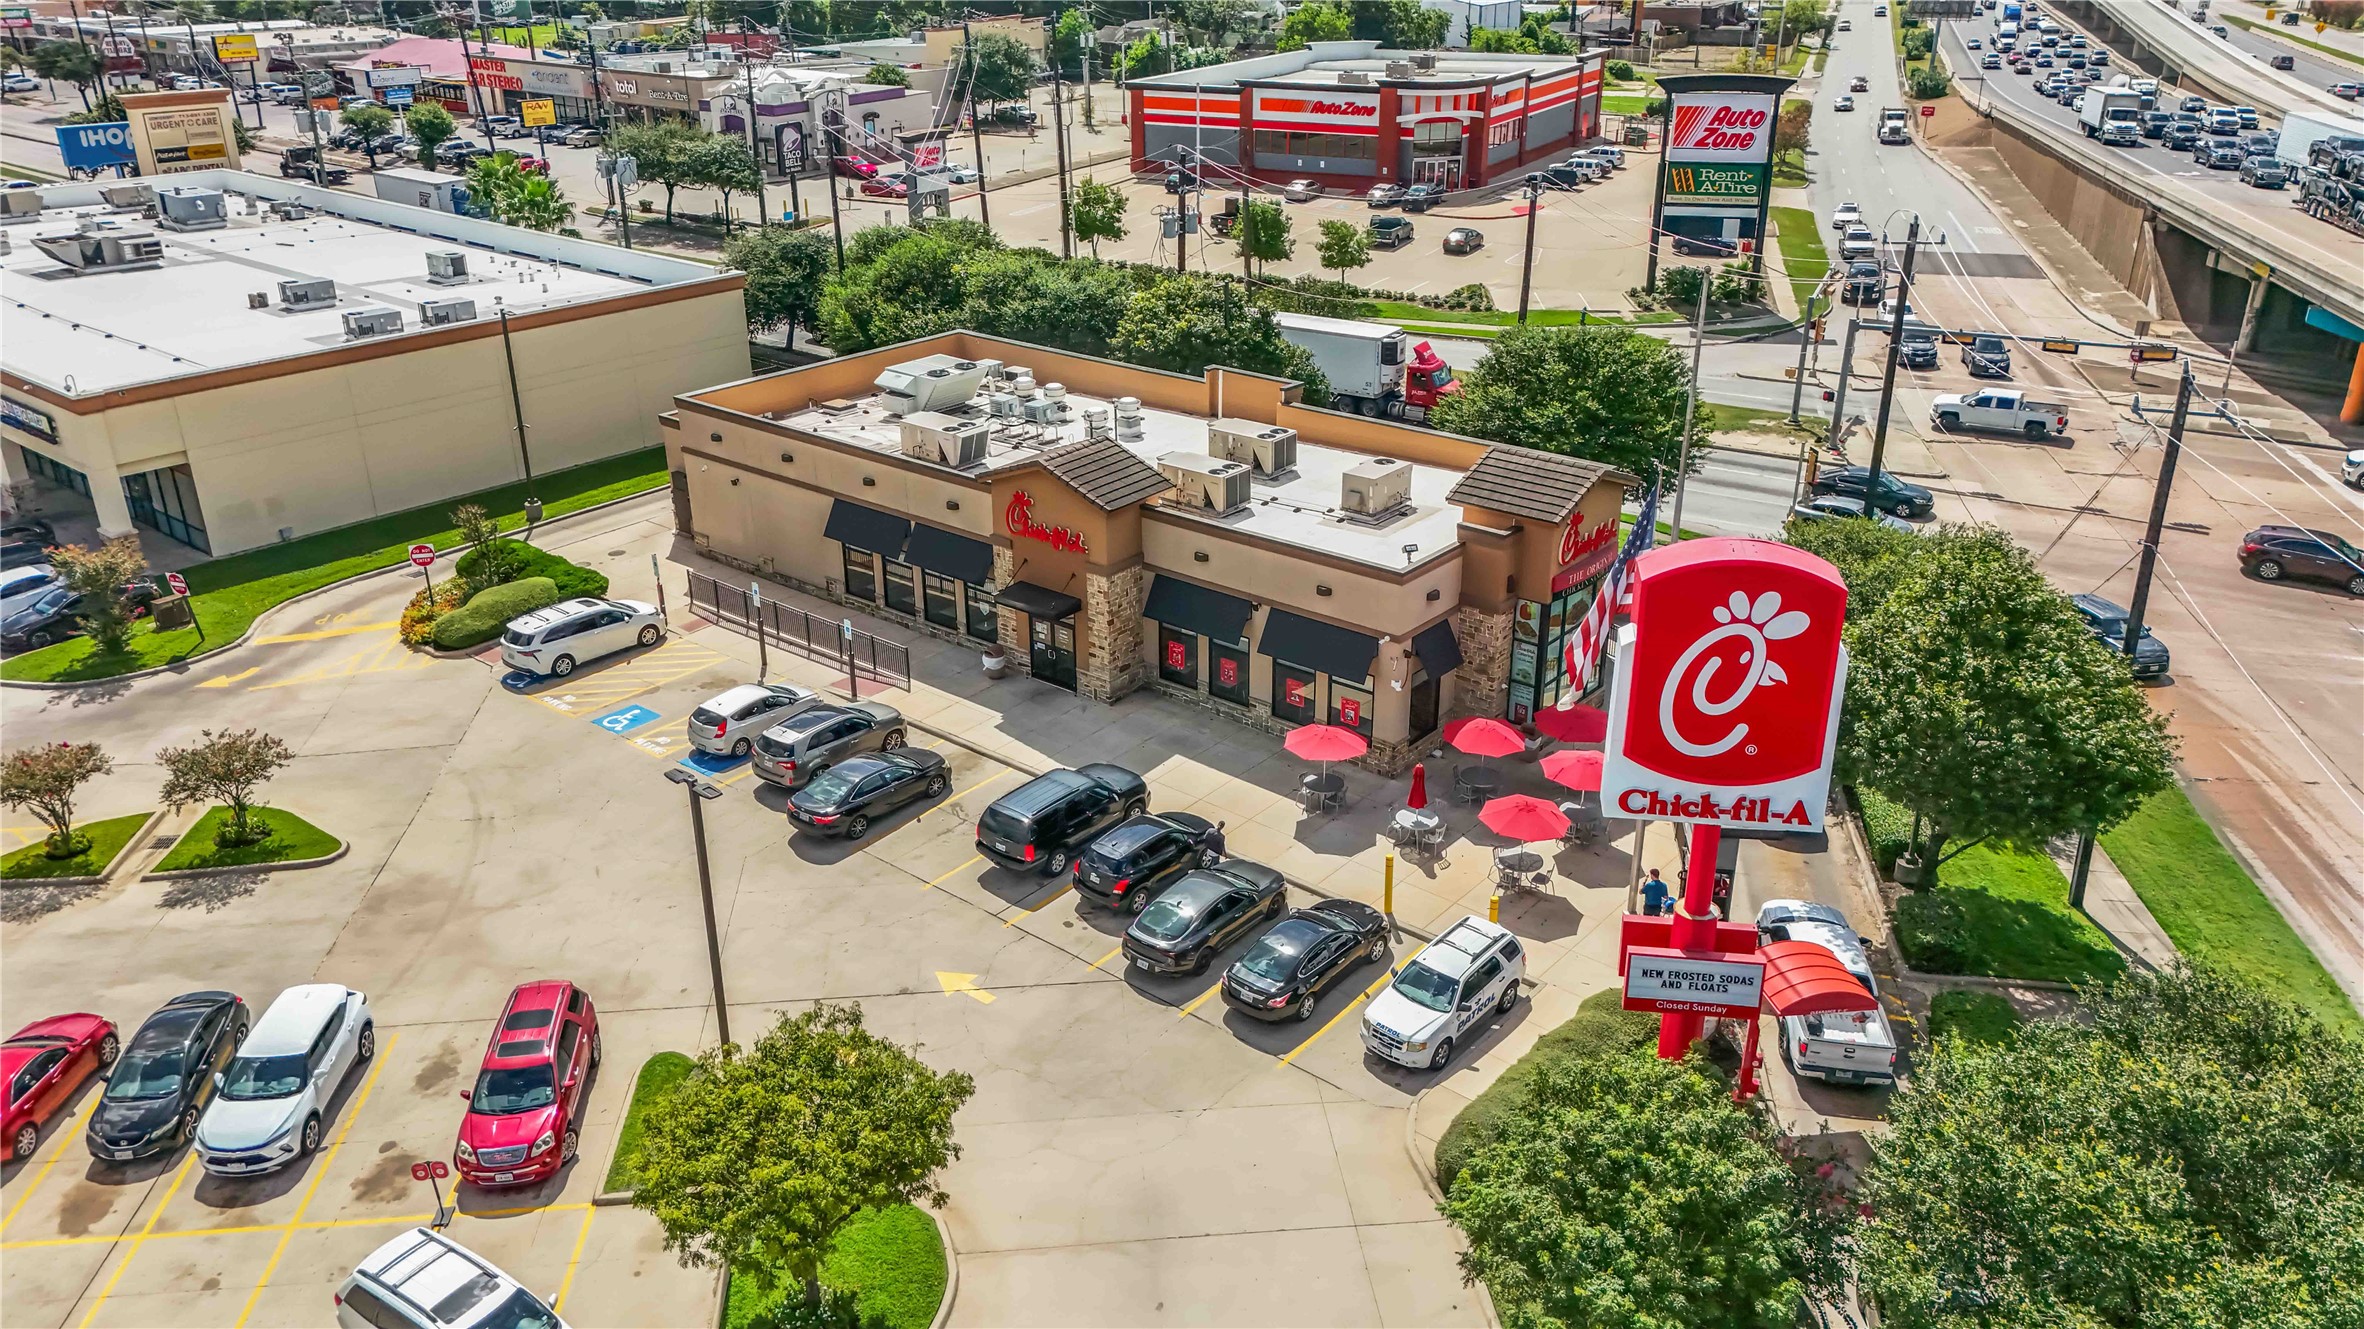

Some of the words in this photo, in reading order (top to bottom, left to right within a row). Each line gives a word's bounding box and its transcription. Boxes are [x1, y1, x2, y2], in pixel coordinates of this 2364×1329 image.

[472, 58, 506, 72] MASTER
[487, 73, 523, 91] STEREO
[526, 101, 549, 111] RAW
[150, 119, 185, 130] URGENT
[195, 117, 218, 127] CARE
[1708, 105, 1767, 129] Auto
[1693, 127, 1756, 150] Zone
[783, 150, 801, 159] TACO
[785, 158, 802, 168] BELL
[1568, 570, 1584, 585] THE
[1617, 788, 1812, 827] Chick-fil-A
[1642, 968, 1665, 978] NEW
[1668, 970, 1715, 982] FROSTED
[1719, 974, 1755, 986] SODAS
[1660, 980, 1683, 989] AND
[1688, 981, 1729, 993] FLOATS
[1456, 993, 1497, 1033] PATROL
[1656, 1000, 1690, 1011] Closed
[1692, 1003, 1728, 1014] Sunday
[1375, 1021, 1402, 1038] PATROL
